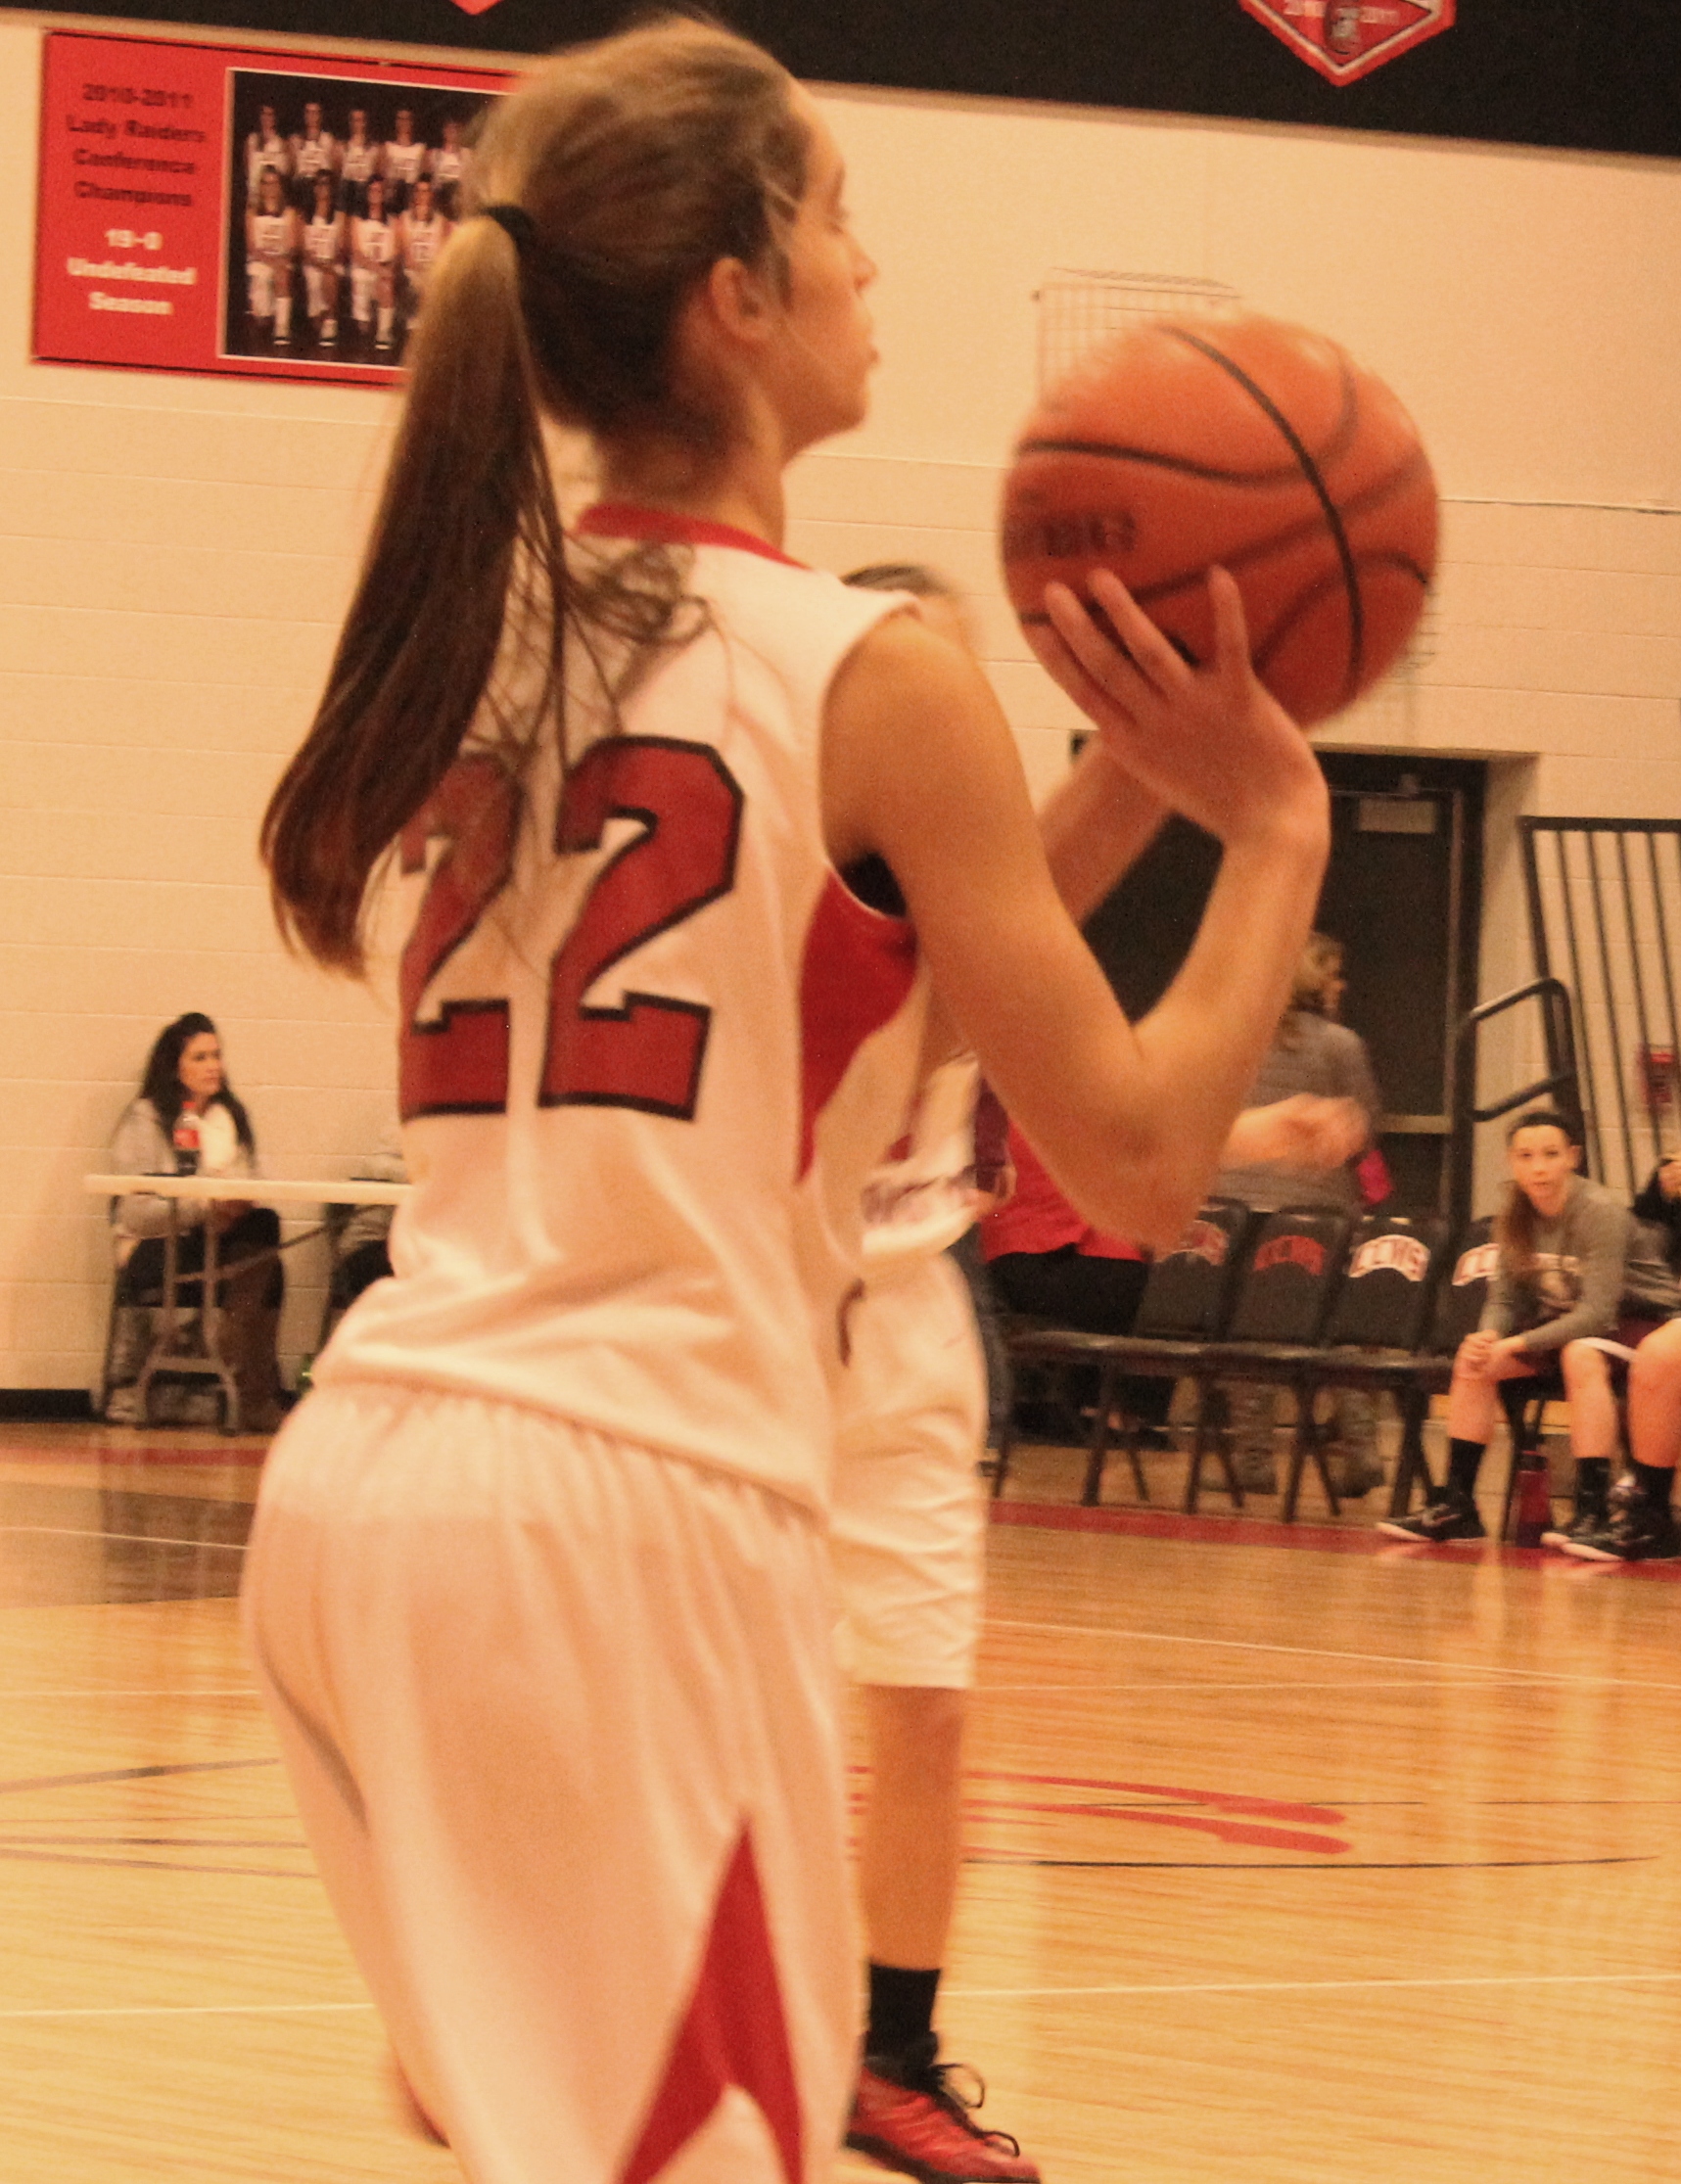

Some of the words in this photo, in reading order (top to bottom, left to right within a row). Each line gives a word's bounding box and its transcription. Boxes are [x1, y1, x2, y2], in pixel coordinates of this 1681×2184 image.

[66, 115, 117, 139] Lady
[125, 119, 206, 143] Raiders
[73, 148, 195, 174] Conference
[74, 180, 192, 206] Champions
[67, 256, 198, 286] Undefeated
[88, 291, 174, 315] Season
[396, 733, 745, 1123] 22
